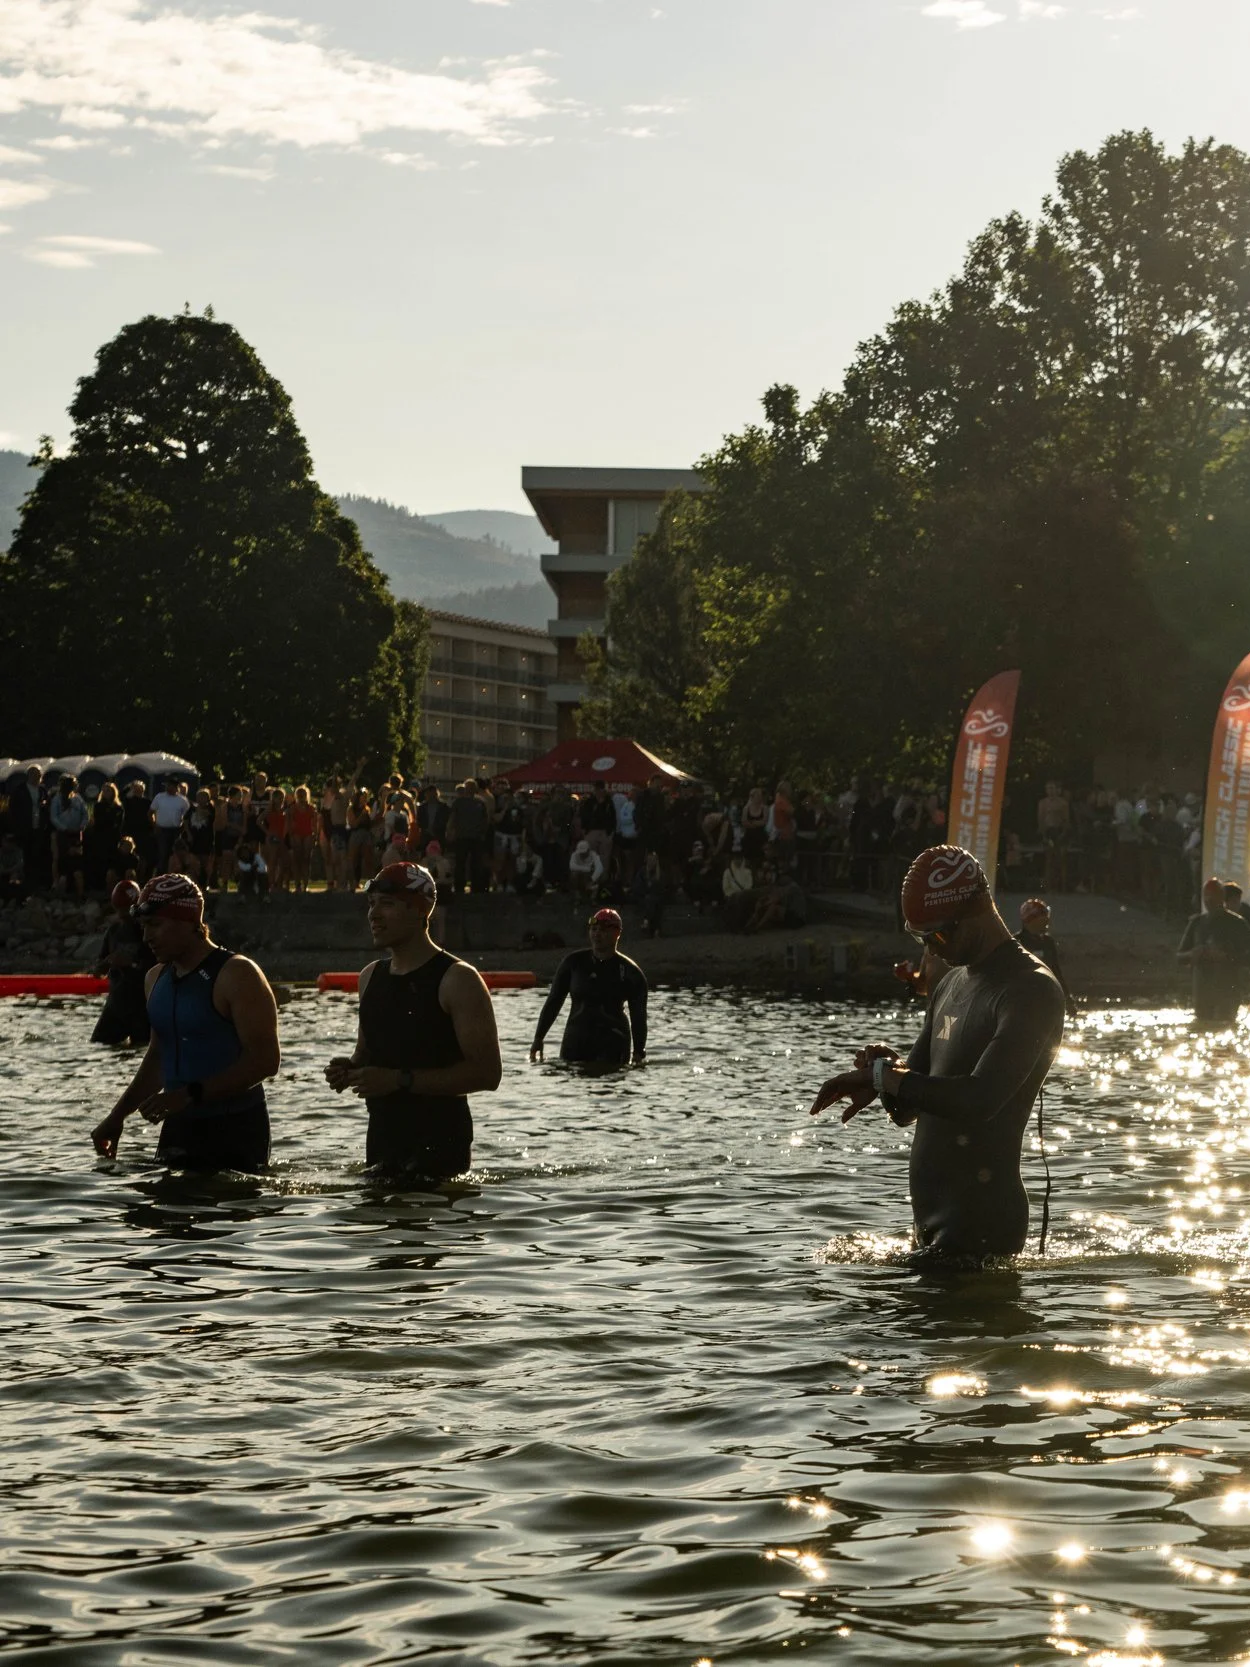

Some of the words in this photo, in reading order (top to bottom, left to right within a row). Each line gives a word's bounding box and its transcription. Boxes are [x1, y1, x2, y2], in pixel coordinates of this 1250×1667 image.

[961, 740, 982, 817] CLASSIC
[979, 745, 998, 810] TRIATHLON
[1218, 718, 1243, 801] CLASSIC
[1213, 807, 1231, 873] PEACH
[1231, 800, 1249, 873] PENTICTON
[923, 888, 956, 900] PEACH
